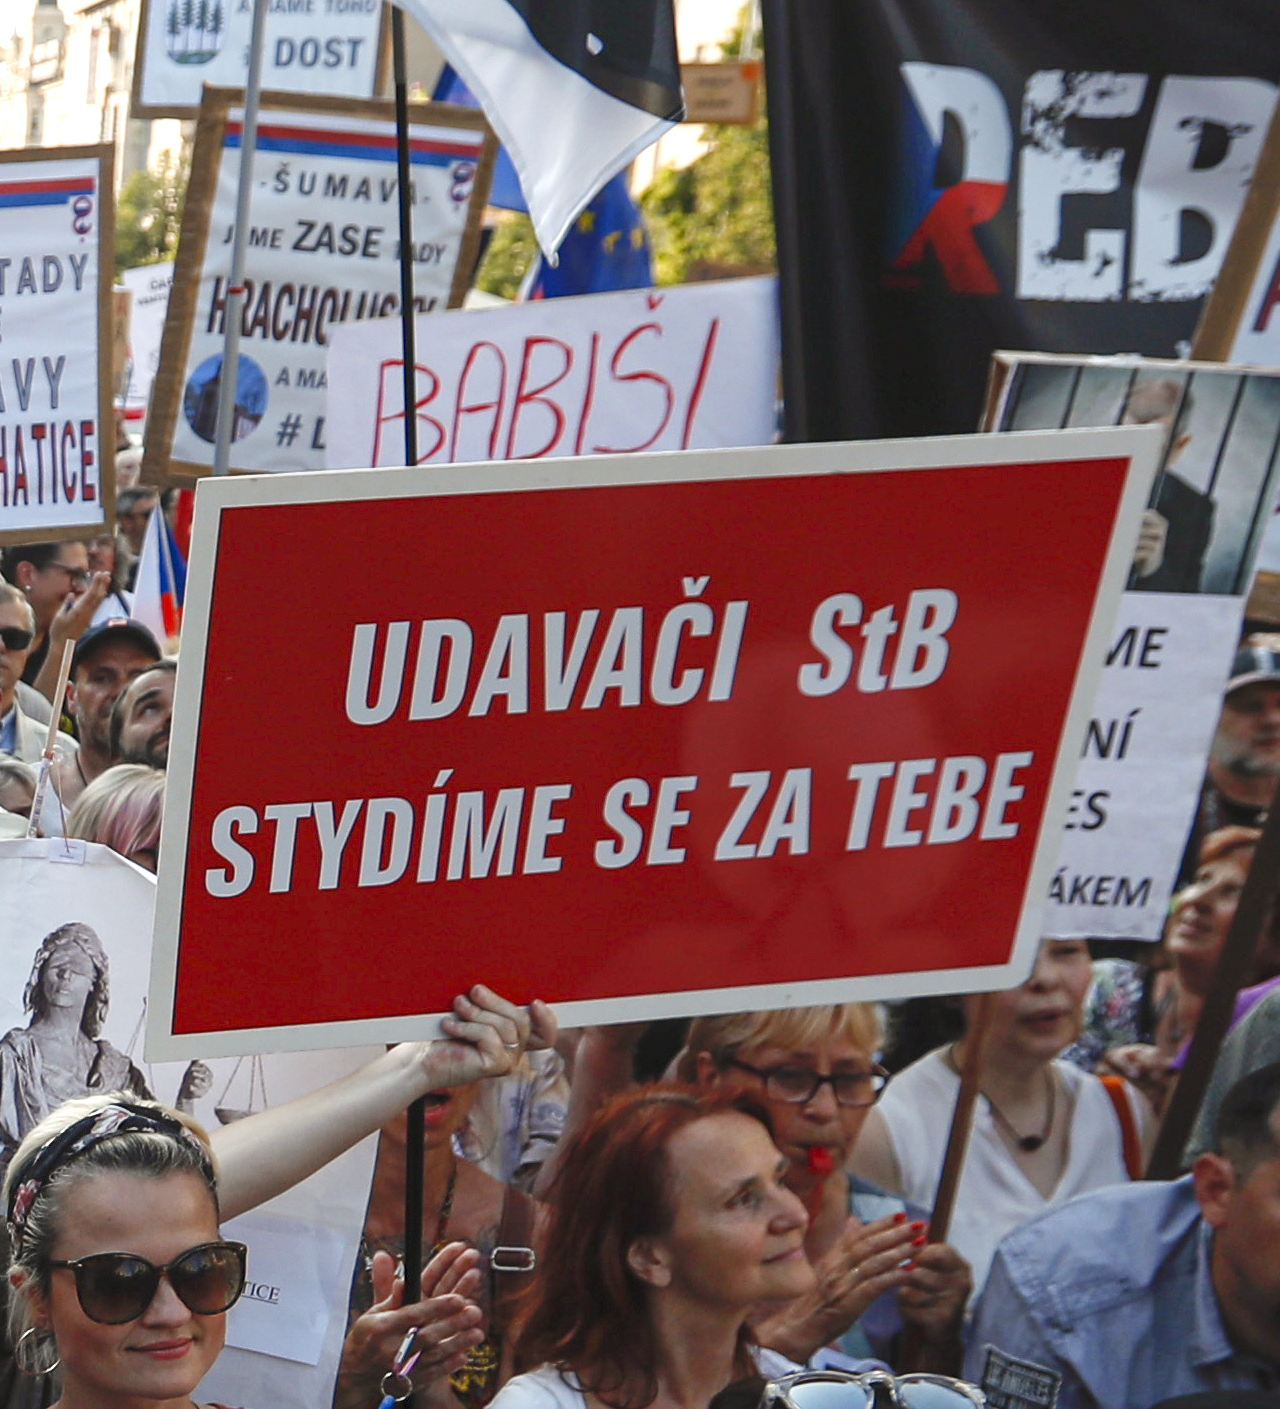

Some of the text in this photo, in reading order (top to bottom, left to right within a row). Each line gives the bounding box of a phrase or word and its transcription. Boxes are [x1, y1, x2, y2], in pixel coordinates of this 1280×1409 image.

[275, 38, 364, 68] DOST
[223, 224, 285, 248] JME
[292, 218, 385, 259] ZASE
[345, 576, 960, 727] UDAVAČI StB
[204, 750, 1036, 899] STYDÍME SE ZA TEBE
